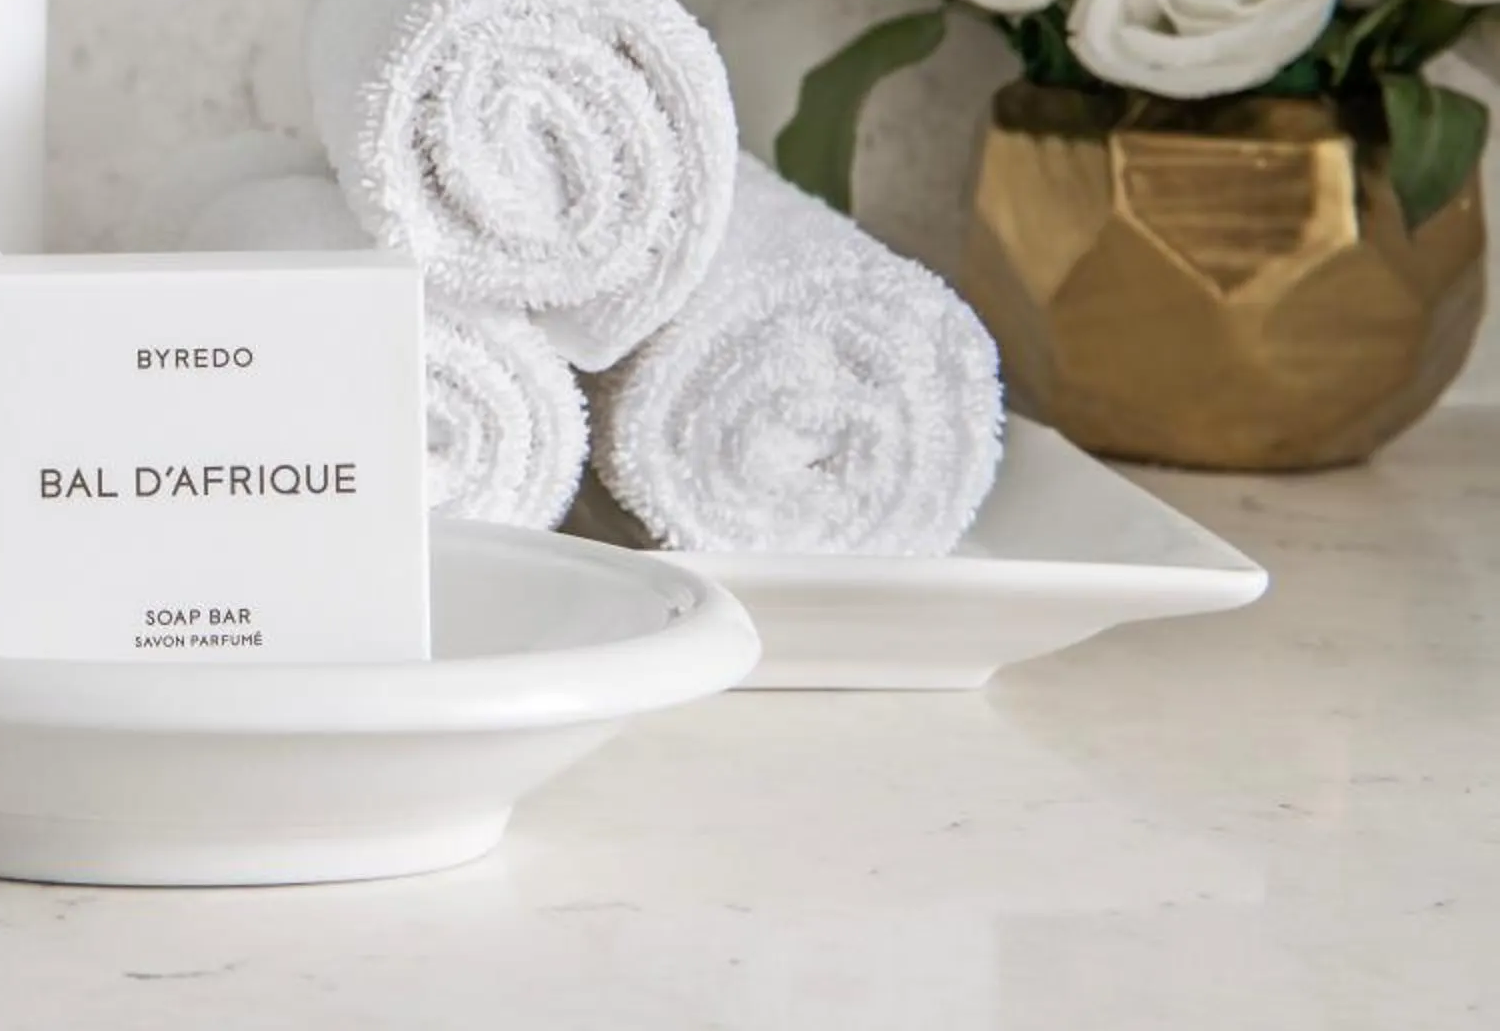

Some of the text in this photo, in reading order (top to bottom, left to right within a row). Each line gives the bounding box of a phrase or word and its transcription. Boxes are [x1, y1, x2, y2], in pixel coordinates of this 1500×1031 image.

[136, 347, 254, 370] BYREDO
[40, 463, 357, 499] BAL D'AFRIQUE
[144, 607, 252, 626] SOAP BAR
[135, 630, 263, 648] SAVON PARFUMÉ
